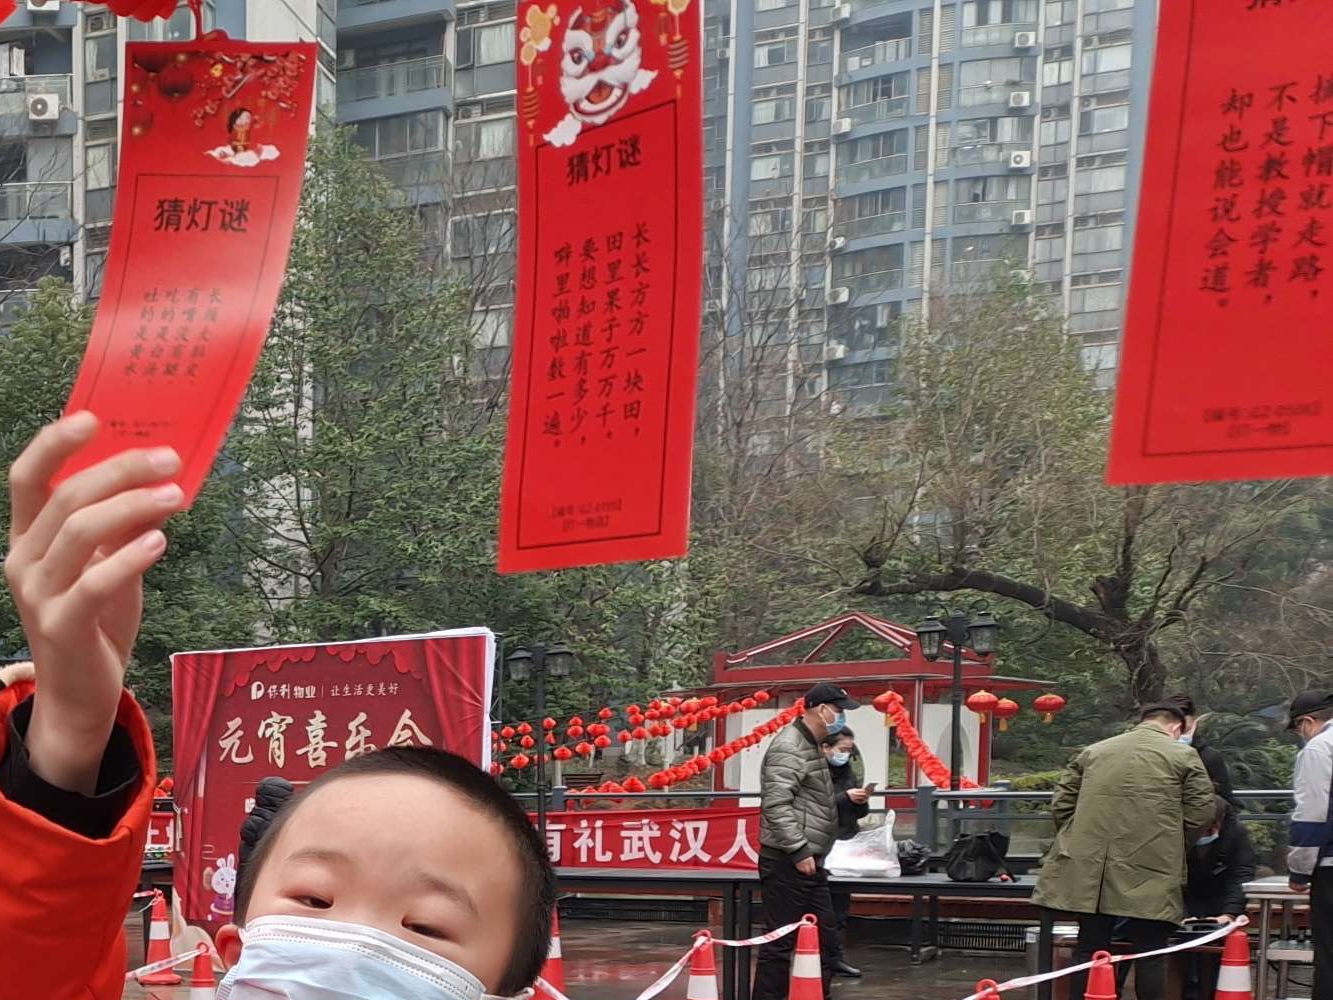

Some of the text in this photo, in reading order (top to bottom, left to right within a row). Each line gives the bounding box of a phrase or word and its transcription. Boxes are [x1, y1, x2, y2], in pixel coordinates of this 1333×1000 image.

[567, 134, 642, 187] 猜灯谜
[153, 197, 250, 235] 猜灯谜
[267, 683, 399, 699] 保利物业 让生活更美好
